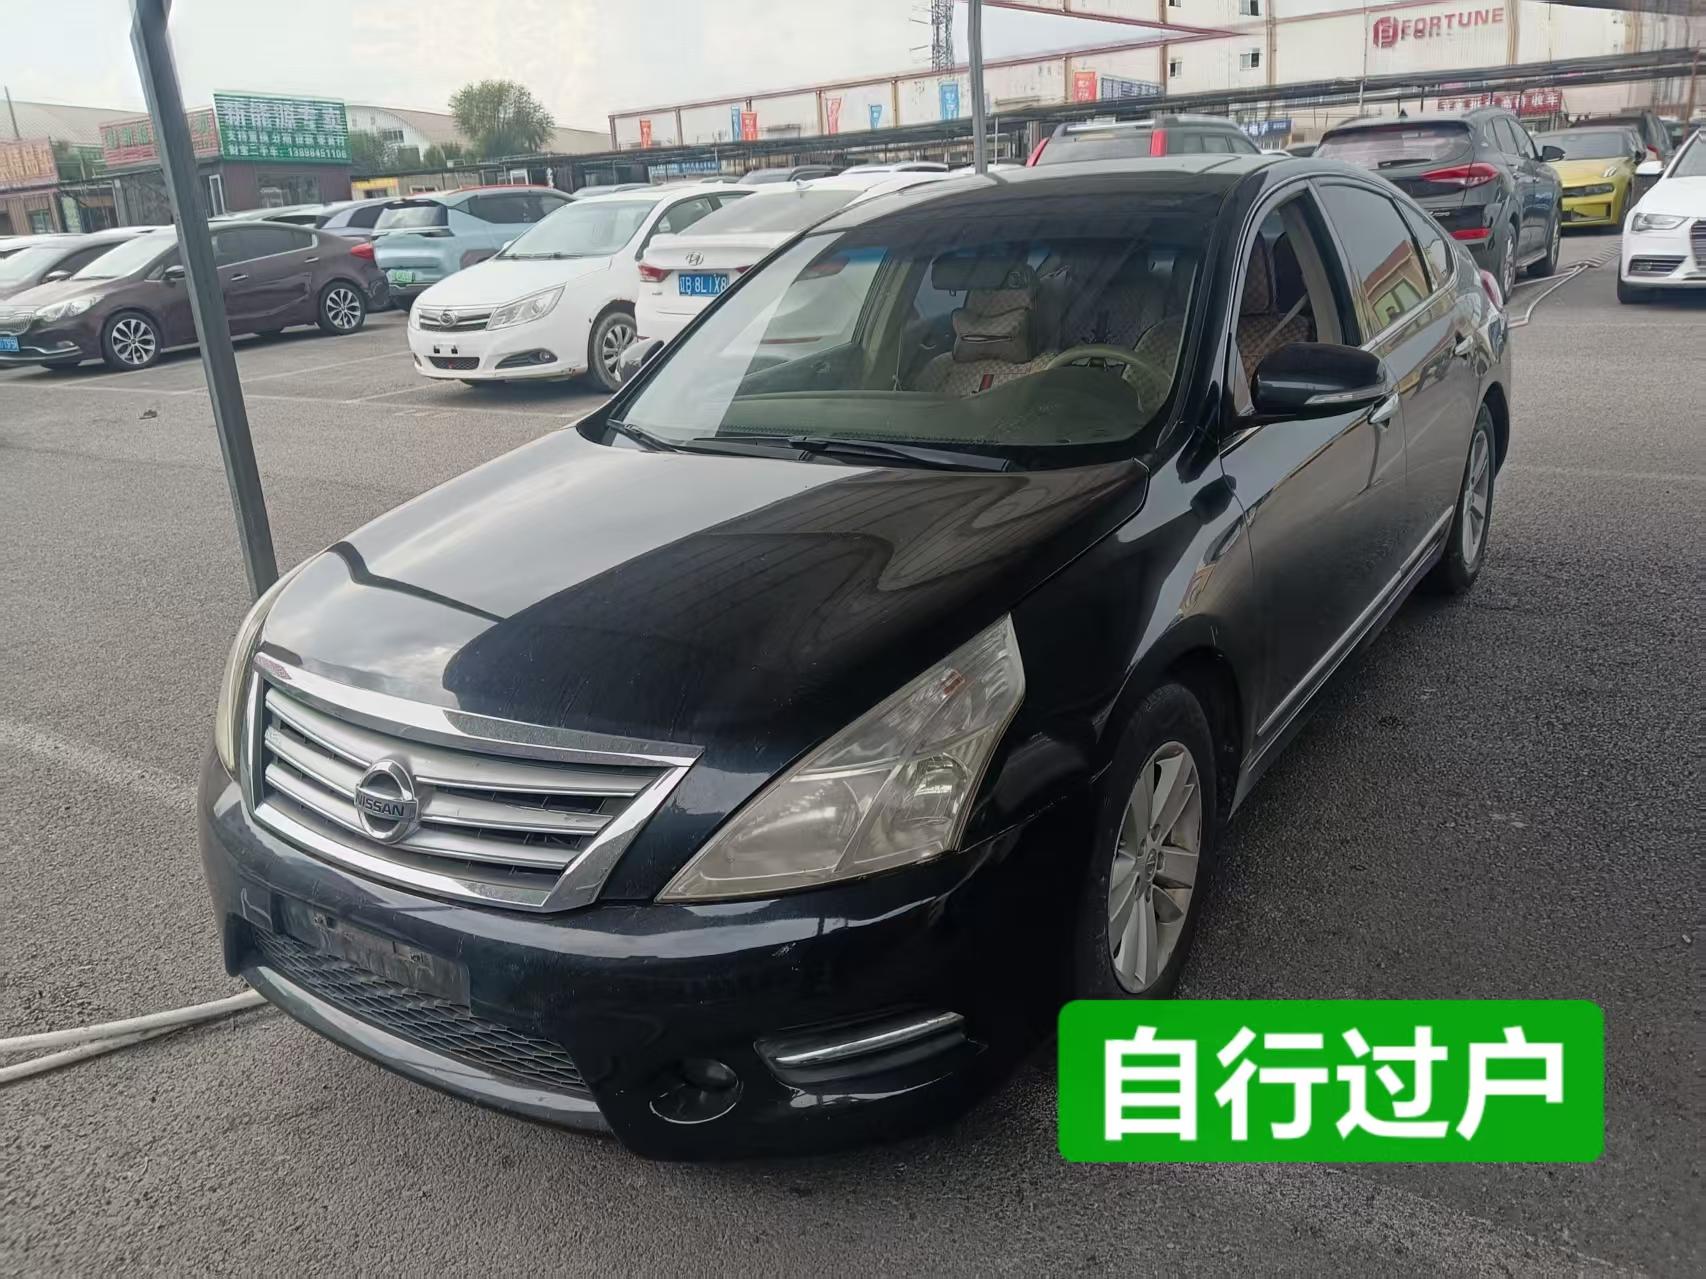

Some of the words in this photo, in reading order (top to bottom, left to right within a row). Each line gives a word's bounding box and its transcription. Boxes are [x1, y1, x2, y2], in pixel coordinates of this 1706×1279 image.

[1401, 7, 1504, 39] FORTUNE
[223, 101, 342, 129] 新能源专卖
[356, 791, 404, 816] NISSAN
